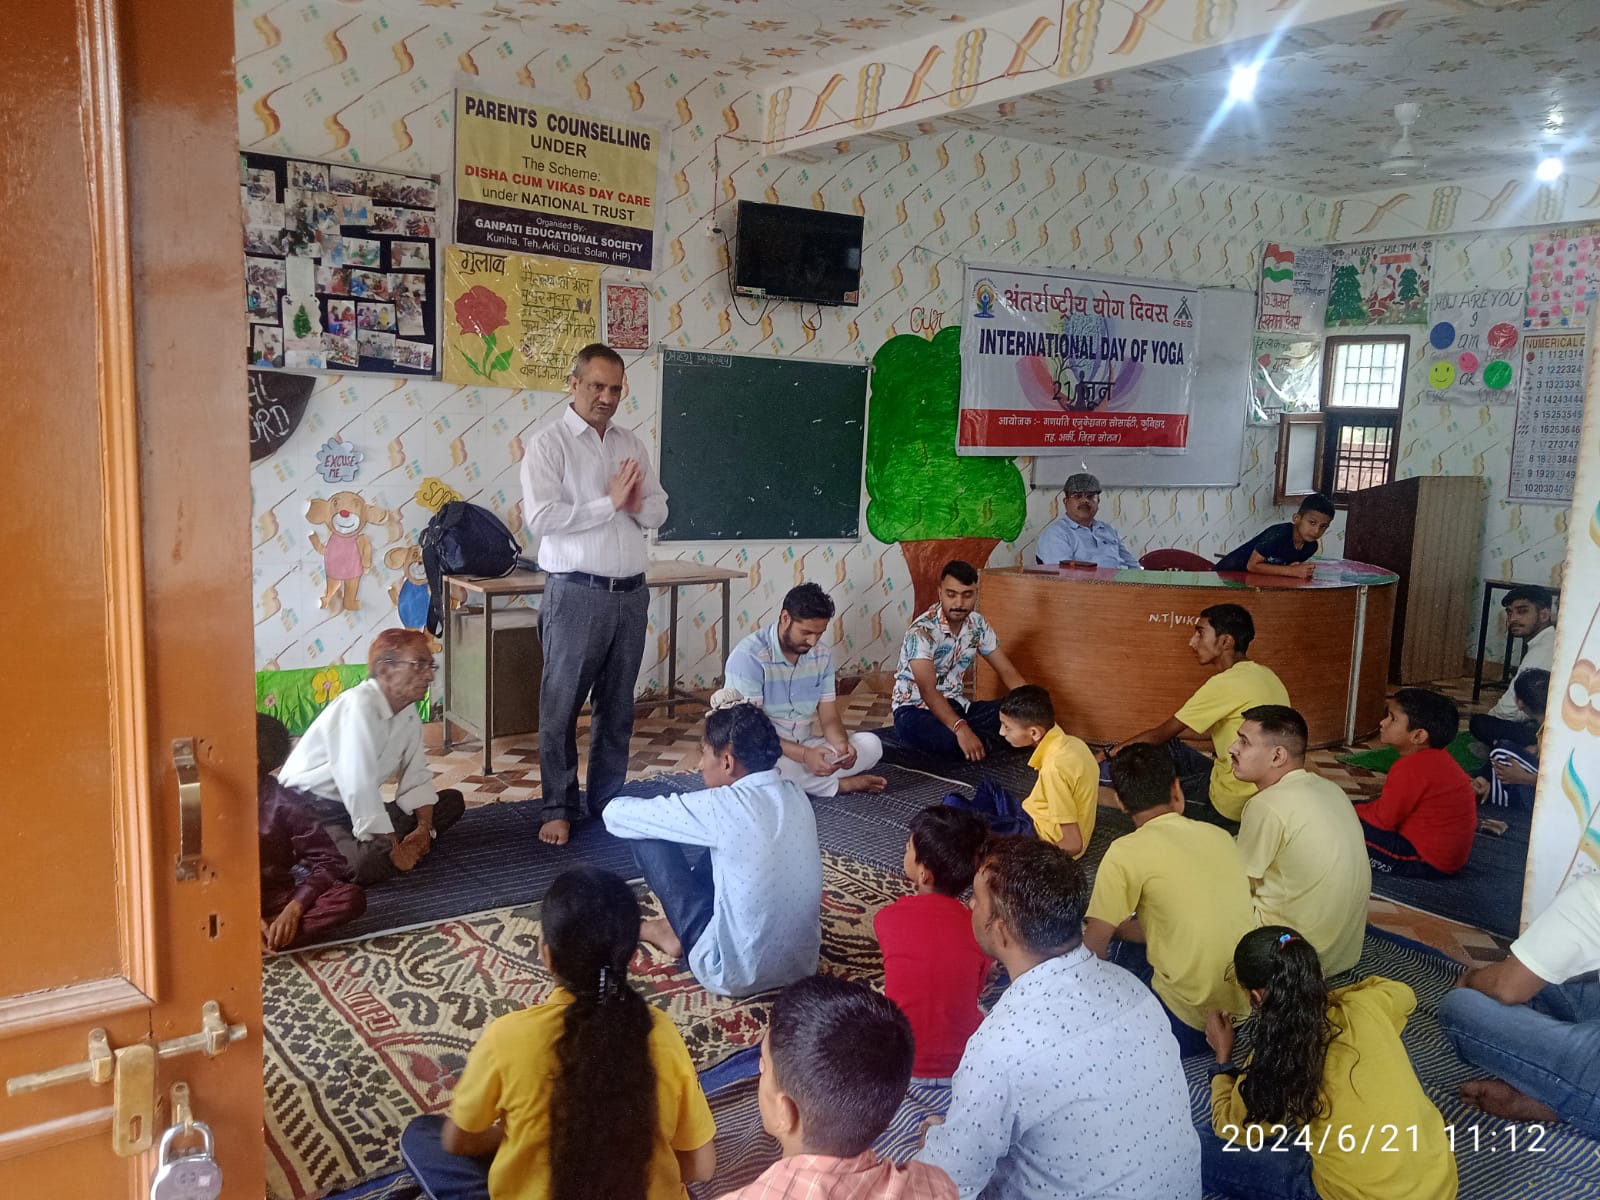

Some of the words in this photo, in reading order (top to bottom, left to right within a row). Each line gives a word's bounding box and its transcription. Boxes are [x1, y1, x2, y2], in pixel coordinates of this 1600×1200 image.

[465, 96, 538, 128] PARENTS
[547, 113, 651, 151] COUNSELLING
[530, 134, 587, 158] UNDER
[522, 156, 545, 171] The
[548, 162, 601, 182] Scheme:
[464, 164, 508, 182] DISHA
[512, 173, 543, 188] CUM
[546, 179, 585, 196] VIKAS
[589, 187, 614, 201] DAY
[617, 192, 651, 207] CARE
[482, 187, 518, 202] under
[521, 192, 588, 214] NATIONAL
[592, 204, 635, 221] TRUST
[475, 218, 523, 234] GANPATI
[525, 226, 598, 246] EDUCATIONAL
[601, 237, 644, 252] SOCIETY
[536, 217, 572, 231] Organised
[459, 250, 508, 276] गुलाब
[612, 251, 631, 264] (HP)
[1004, 283, 1088, 320] अंतर्राष्ट्रीय
[1093, 290, 1125, 319] योग
[1129, 293, 1169, 323] दिवस
[1459, 292, 1488, 309] ARE
[1490, 291, 1523, 307] YOU
[1173, 319, 1193, 328] GES
[979, 328, 1097, 360] INTERNATIONAL
[1101, 337, 1127, 362] DAY
[1130, 339, 1148, 364] OF
[1151, 340, 1184, 365] YOGA
[1526, 337, 1577, 349] NUMERICAL
[1053, 381, 1070, 401] 21
[998, 414, 1032, 425] आयोजक
[324, 455, 357, 467] EXCUSE
[329, 468, 341, 478] ME
